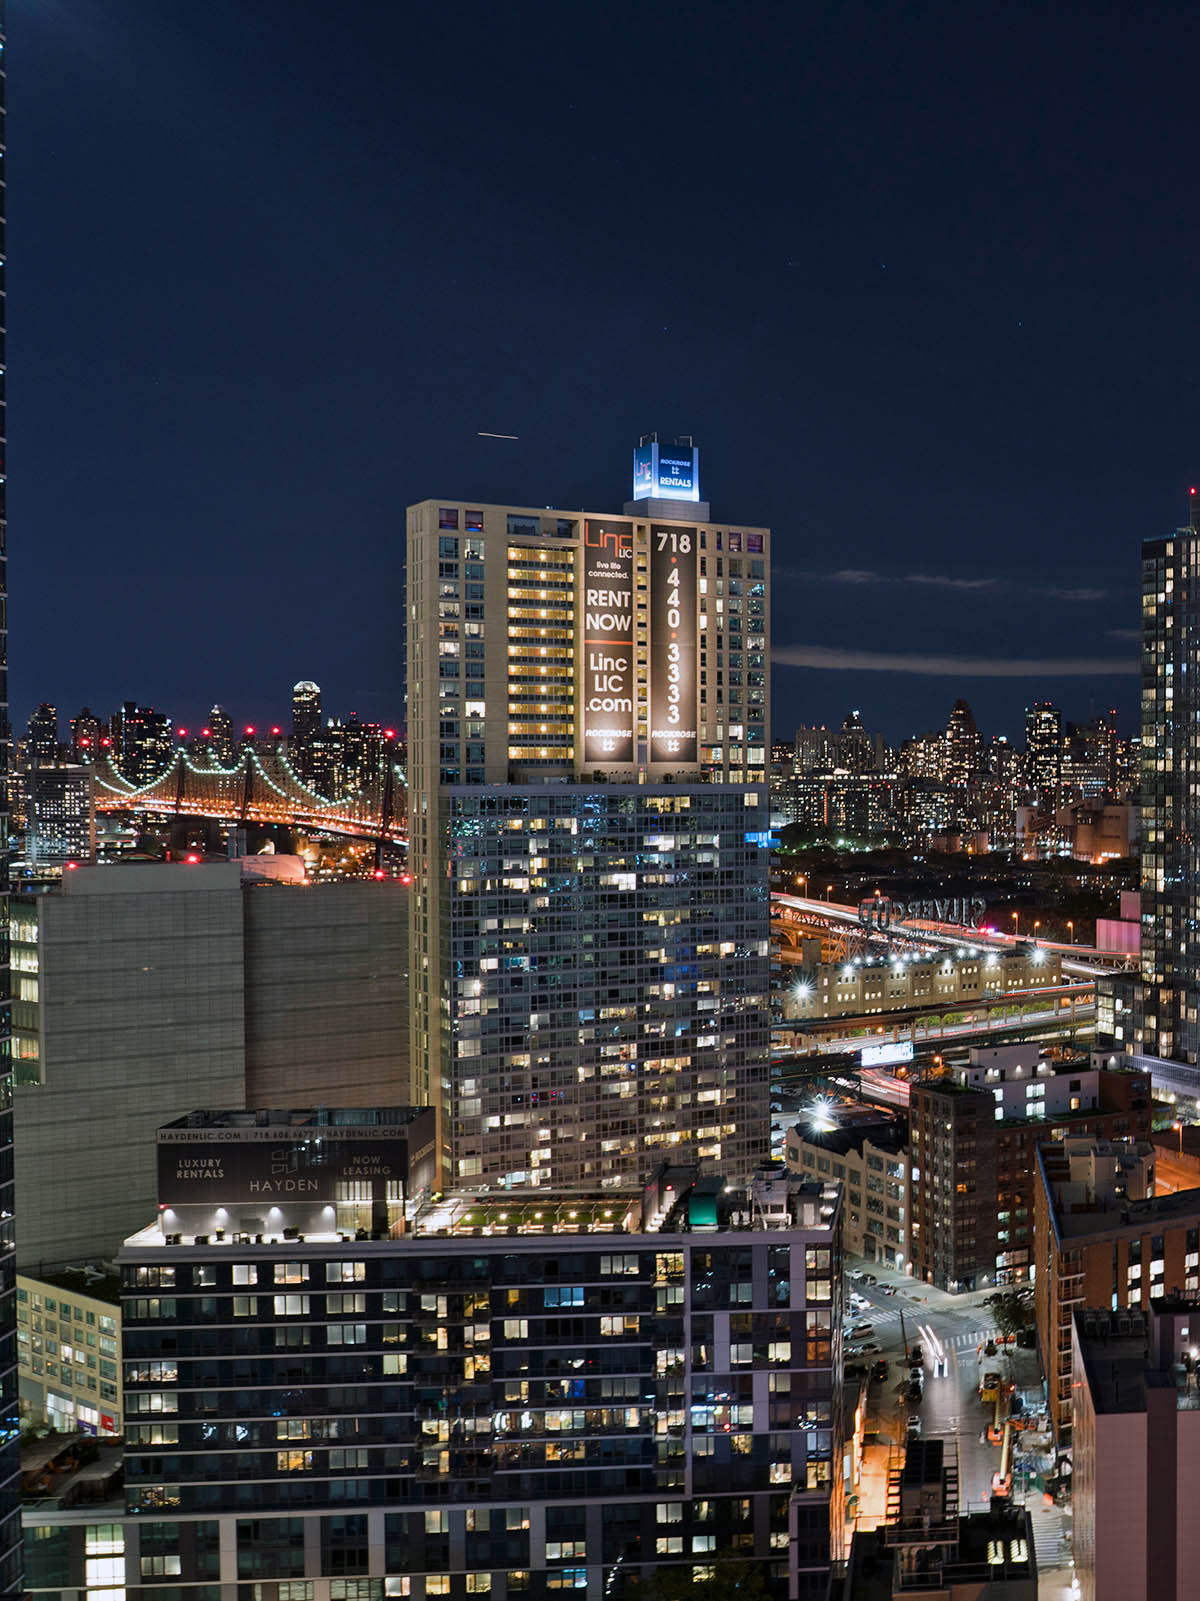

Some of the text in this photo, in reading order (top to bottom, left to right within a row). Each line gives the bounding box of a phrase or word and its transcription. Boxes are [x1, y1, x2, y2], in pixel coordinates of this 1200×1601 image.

[660, 459, 691, 467] ROCKROSE
[660, 477, 692, 487] RENTALS
[585, 521, 632, 558] Linc
[657, 532, 691, 553] 718
[618, 549, 632, 558] LIC
[596, 561, 609, 569] live
[587, 589, 631, 607] RENT
[586, 613, 631, 631] NOW
[590, 653, 627, 671] Linc
[594, 674, 623, 692] LIC
[585, 697, 632, 712] .com
[585, 729, 632, 737] ROCKROSE
[651, 730, 696, 738] ROCKROSE
[160, 1131, 241, 1140] HAYDENLIC.COM
[326, 1128, 406, 1138] HAYDENLIC.COM
[178, 1159, 222, 1168] LUXURY
[352, 1155, 382, 1165] NOW
[176, 1169, 224, 1179] RENTALS
[343, 1166, 391, 1176] LEASING
[250, 1179, 319, 1192] HAYDEN
